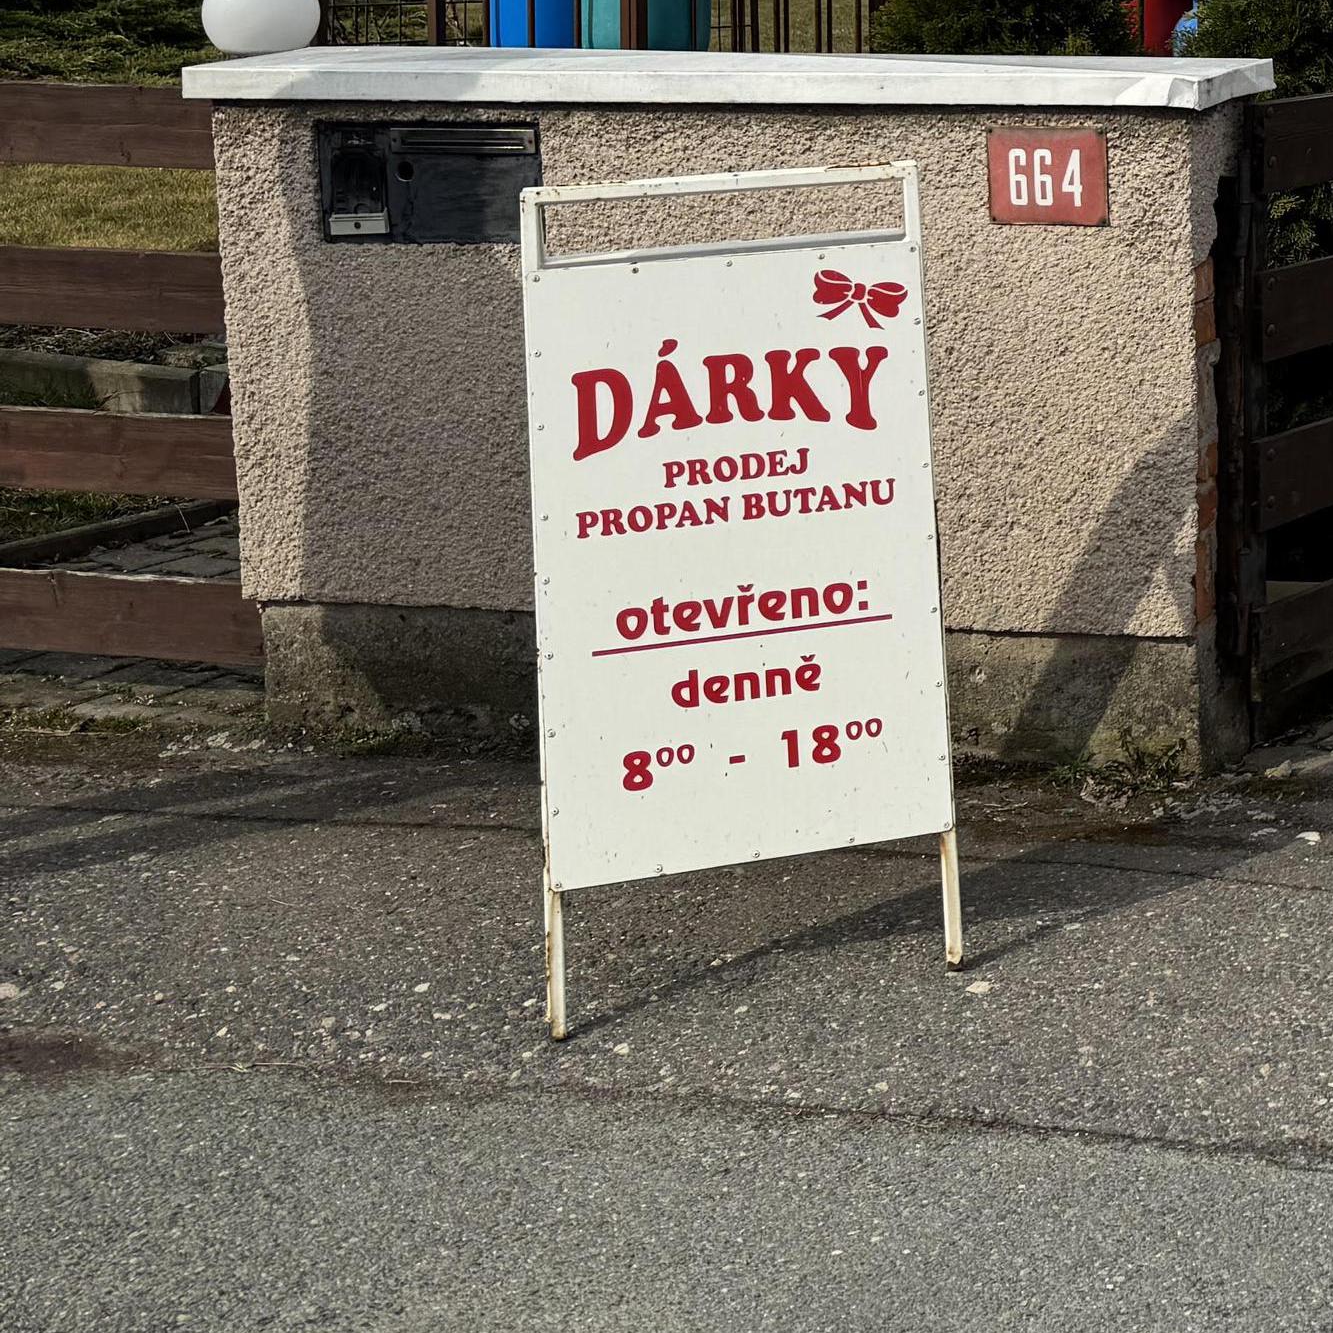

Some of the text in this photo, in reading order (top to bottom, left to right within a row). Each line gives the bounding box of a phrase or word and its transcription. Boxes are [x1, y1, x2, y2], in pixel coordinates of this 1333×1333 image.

[1008, 148, 1083, 207] 664
[571, 338, 889, 461] DÁRKY
[663, 448, 810, 488] PRODEJ
[576, 478, 896, 539] PROPAN BUTANU
[615, 580, 869, 641] otevřeno:
[671, 654, 822, 709] denně
[729, 754, 746, 765] -
